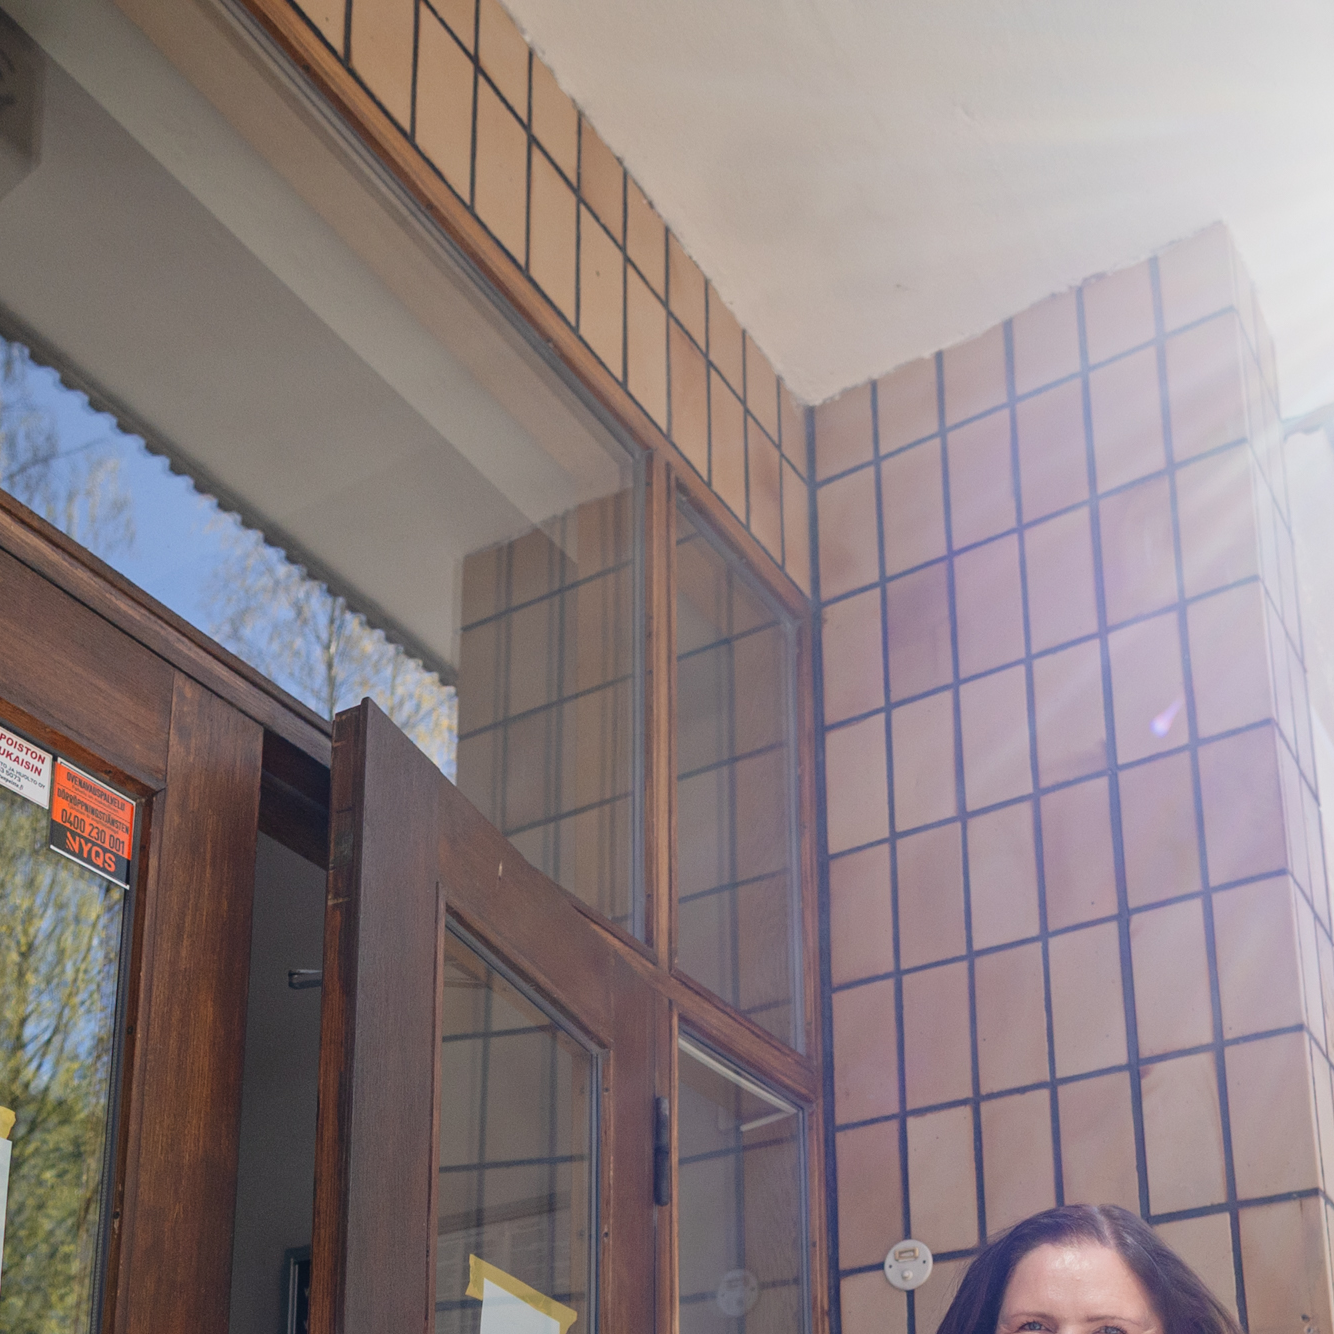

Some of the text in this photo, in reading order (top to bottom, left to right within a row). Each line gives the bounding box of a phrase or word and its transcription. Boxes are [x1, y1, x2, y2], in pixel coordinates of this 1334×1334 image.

[66, 771, 126, 812] OVENAVAUSPALVELU
[61, 808, 86, 834] 0400
[88, 823, 107, 845] 230
[108, 834, 126, 856] 001
[65, 830, 117, 873] NYQS
